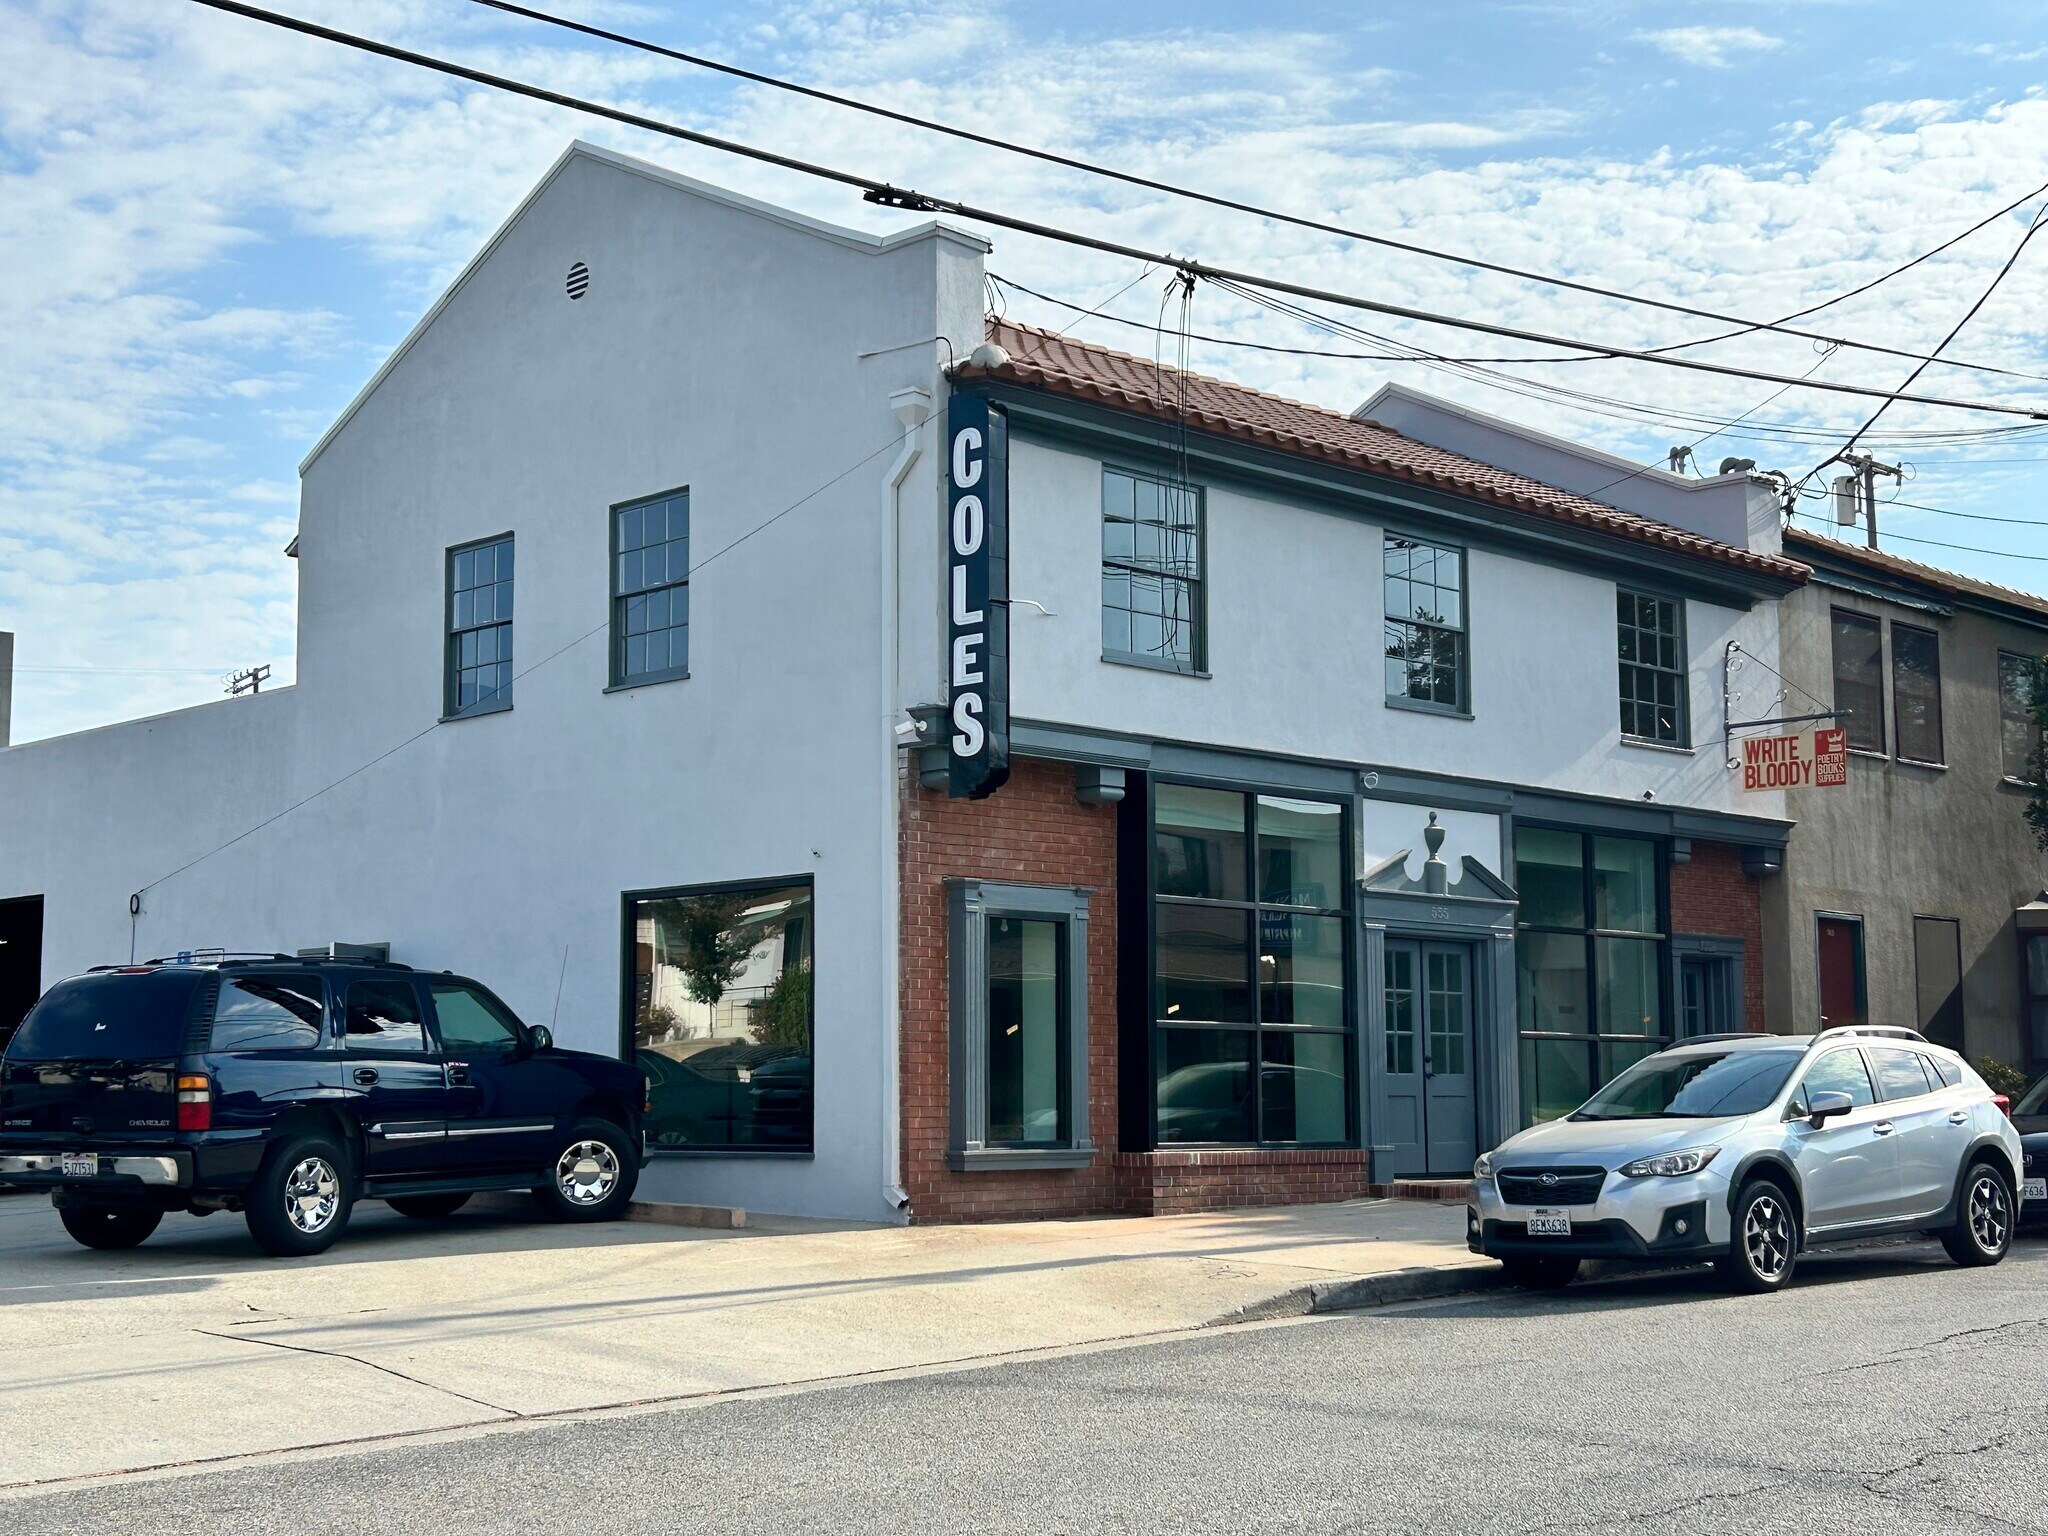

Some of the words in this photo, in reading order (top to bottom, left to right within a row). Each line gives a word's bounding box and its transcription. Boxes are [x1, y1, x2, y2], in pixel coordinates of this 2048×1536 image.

[953, 427, 984, 757] COLES
[1744, 737, 1799, 764] WRITE
[1817, 754, 1844, 764] POETRY
[1817, 763, 1845, 774] BOOKS
[1744, 760, 1812, 789] BLOODY
[1817, 773, 1845, 783] SUPPLIES
[129, 1119, 170, 1127] CHEVROLET
[2024, 1186, 2045, 1196] F636
